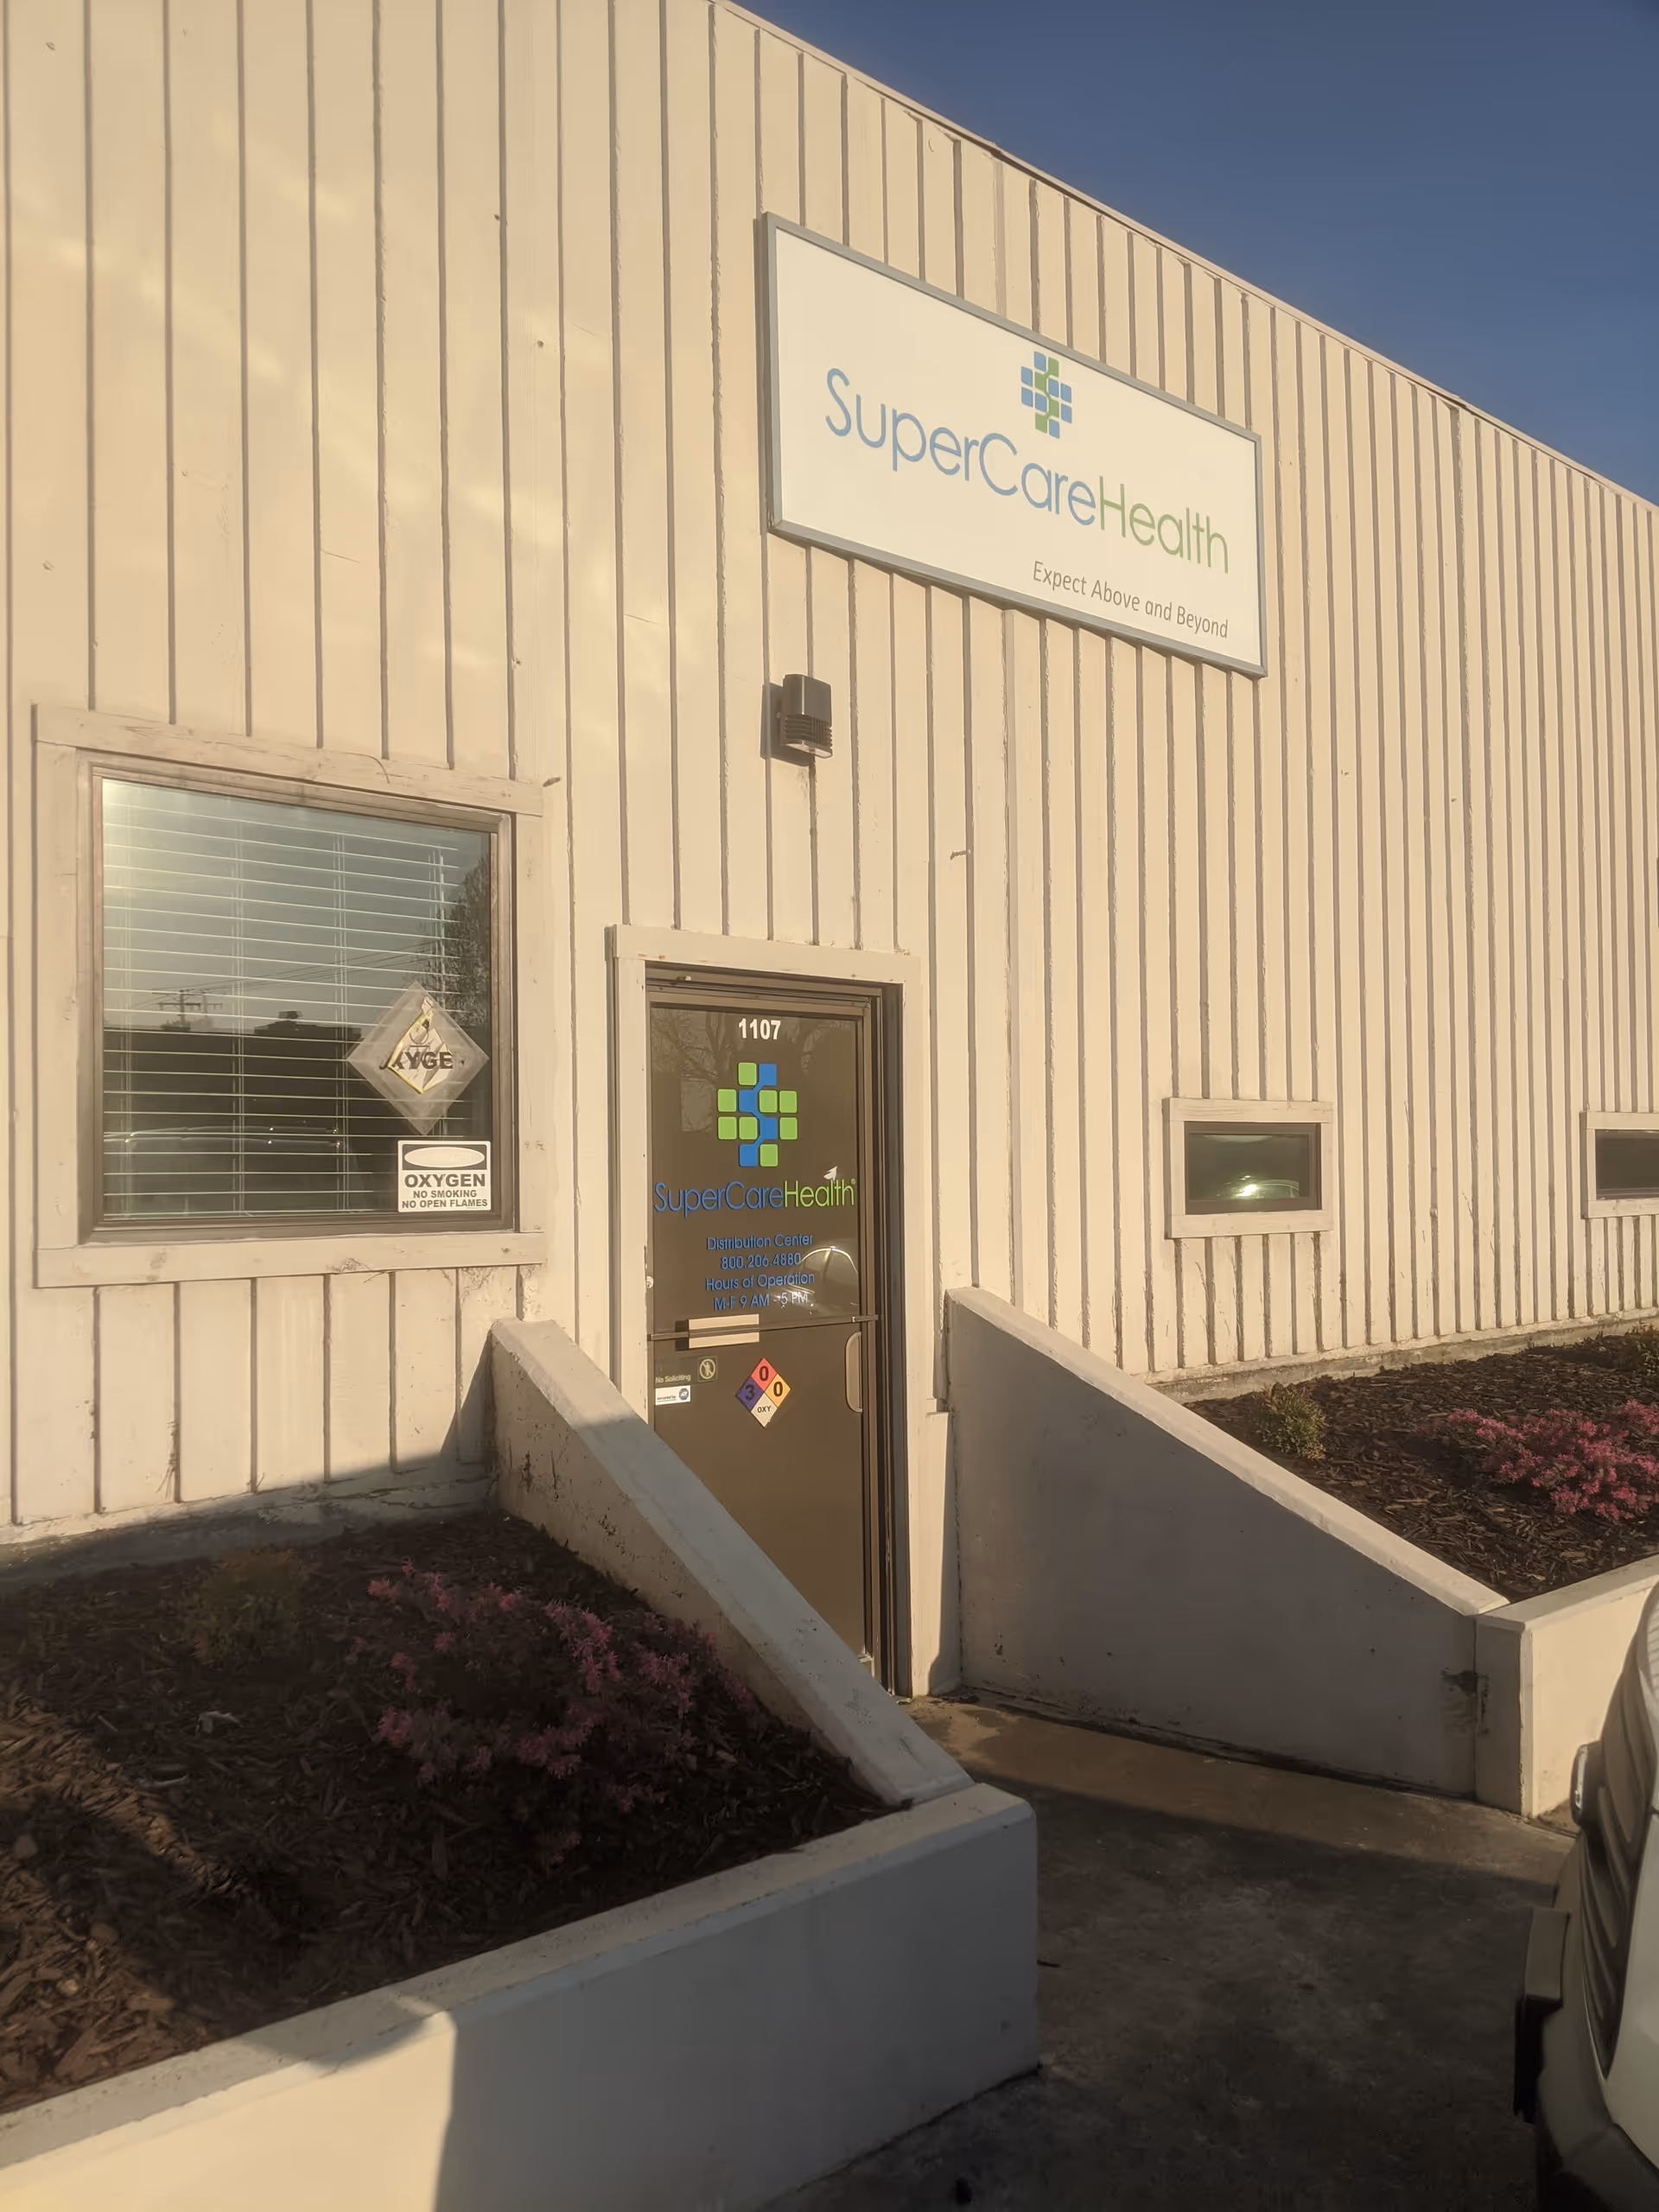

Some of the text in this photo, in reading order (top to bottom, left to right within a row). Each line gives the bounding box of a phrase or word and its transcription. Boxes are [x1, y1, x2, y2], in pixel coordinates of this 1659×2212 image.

[1033, 560, 1229, 639] Expect Above and Beyond
[738, 1018, 781, 1040] 1107
[404, 1173, 486, 1188] OXYGEN
[413, 1189, 477, 1198] NO SMOKING
[402, 1198, 488, 1209] NO OPEN FLAMES
[706, 1234, 814, 1250] Distribution Center
[720, 1253, 802, 1270] 800.206.4880
[705, 1272, 815, 1291] Hours of Operation
[740, 1295, 747, 1309] 9
[749, 1294, 770, 1307] AM
[780, 1292, 788, 1305] 5
[791, 1291, 808, 1304] PM
[664, 1374, 691, 1382] Soliciting
[760, 1366, 769, 1381] 0
[745, 1381, 784, 1402] 3 0
[757, 1405, 772, 1414] OXY
